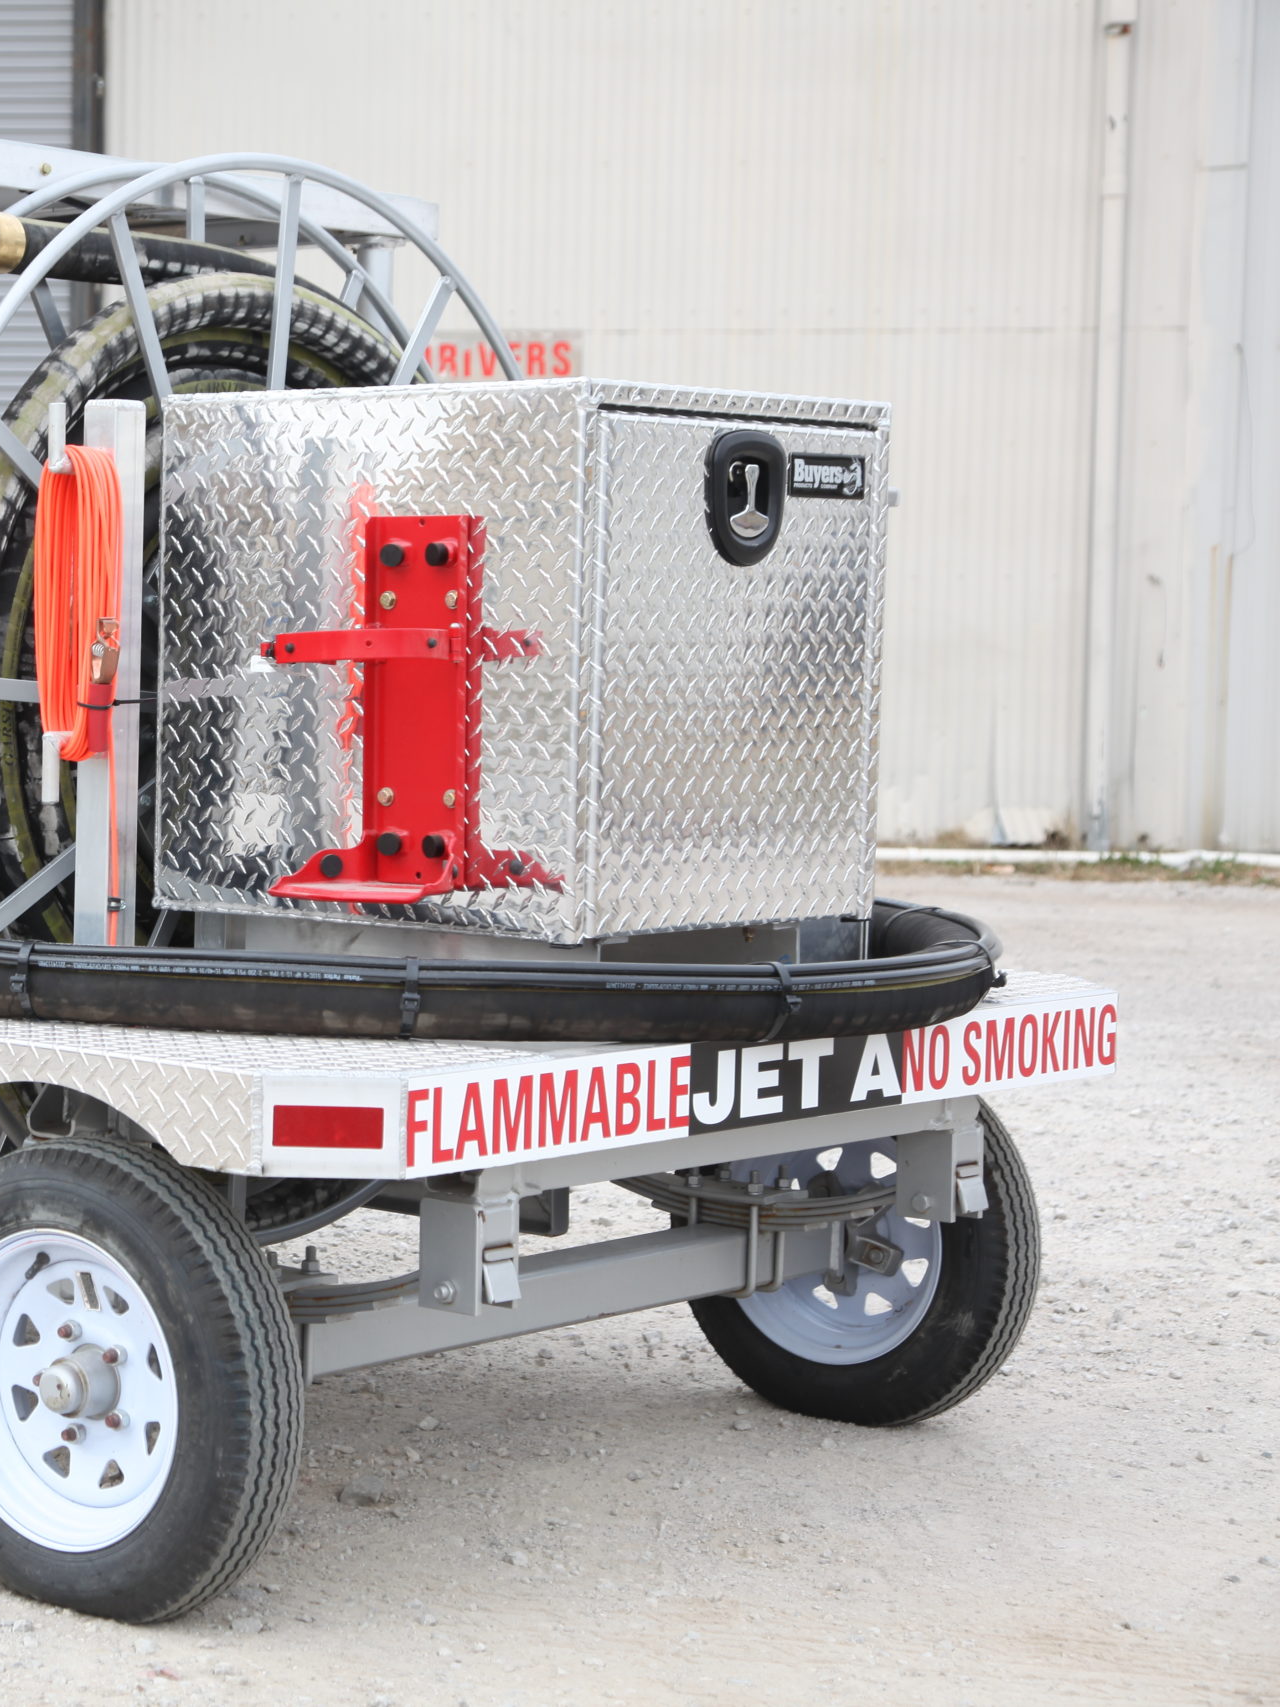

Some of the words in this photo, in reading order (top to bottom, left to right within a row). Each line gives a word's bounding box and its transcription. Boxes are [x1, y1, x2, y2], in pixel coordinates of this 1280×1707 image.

[794, 458, 843, 488] Buyers
[692, 1037, 834, 1125] JET
[850, 1033, 902, 1102] A
[901, 1025, 950, 1093] NO
[962, 1003, 1117, 1087] SMOKING
[407, 1055, 691, 1168] FLAMMABLE
